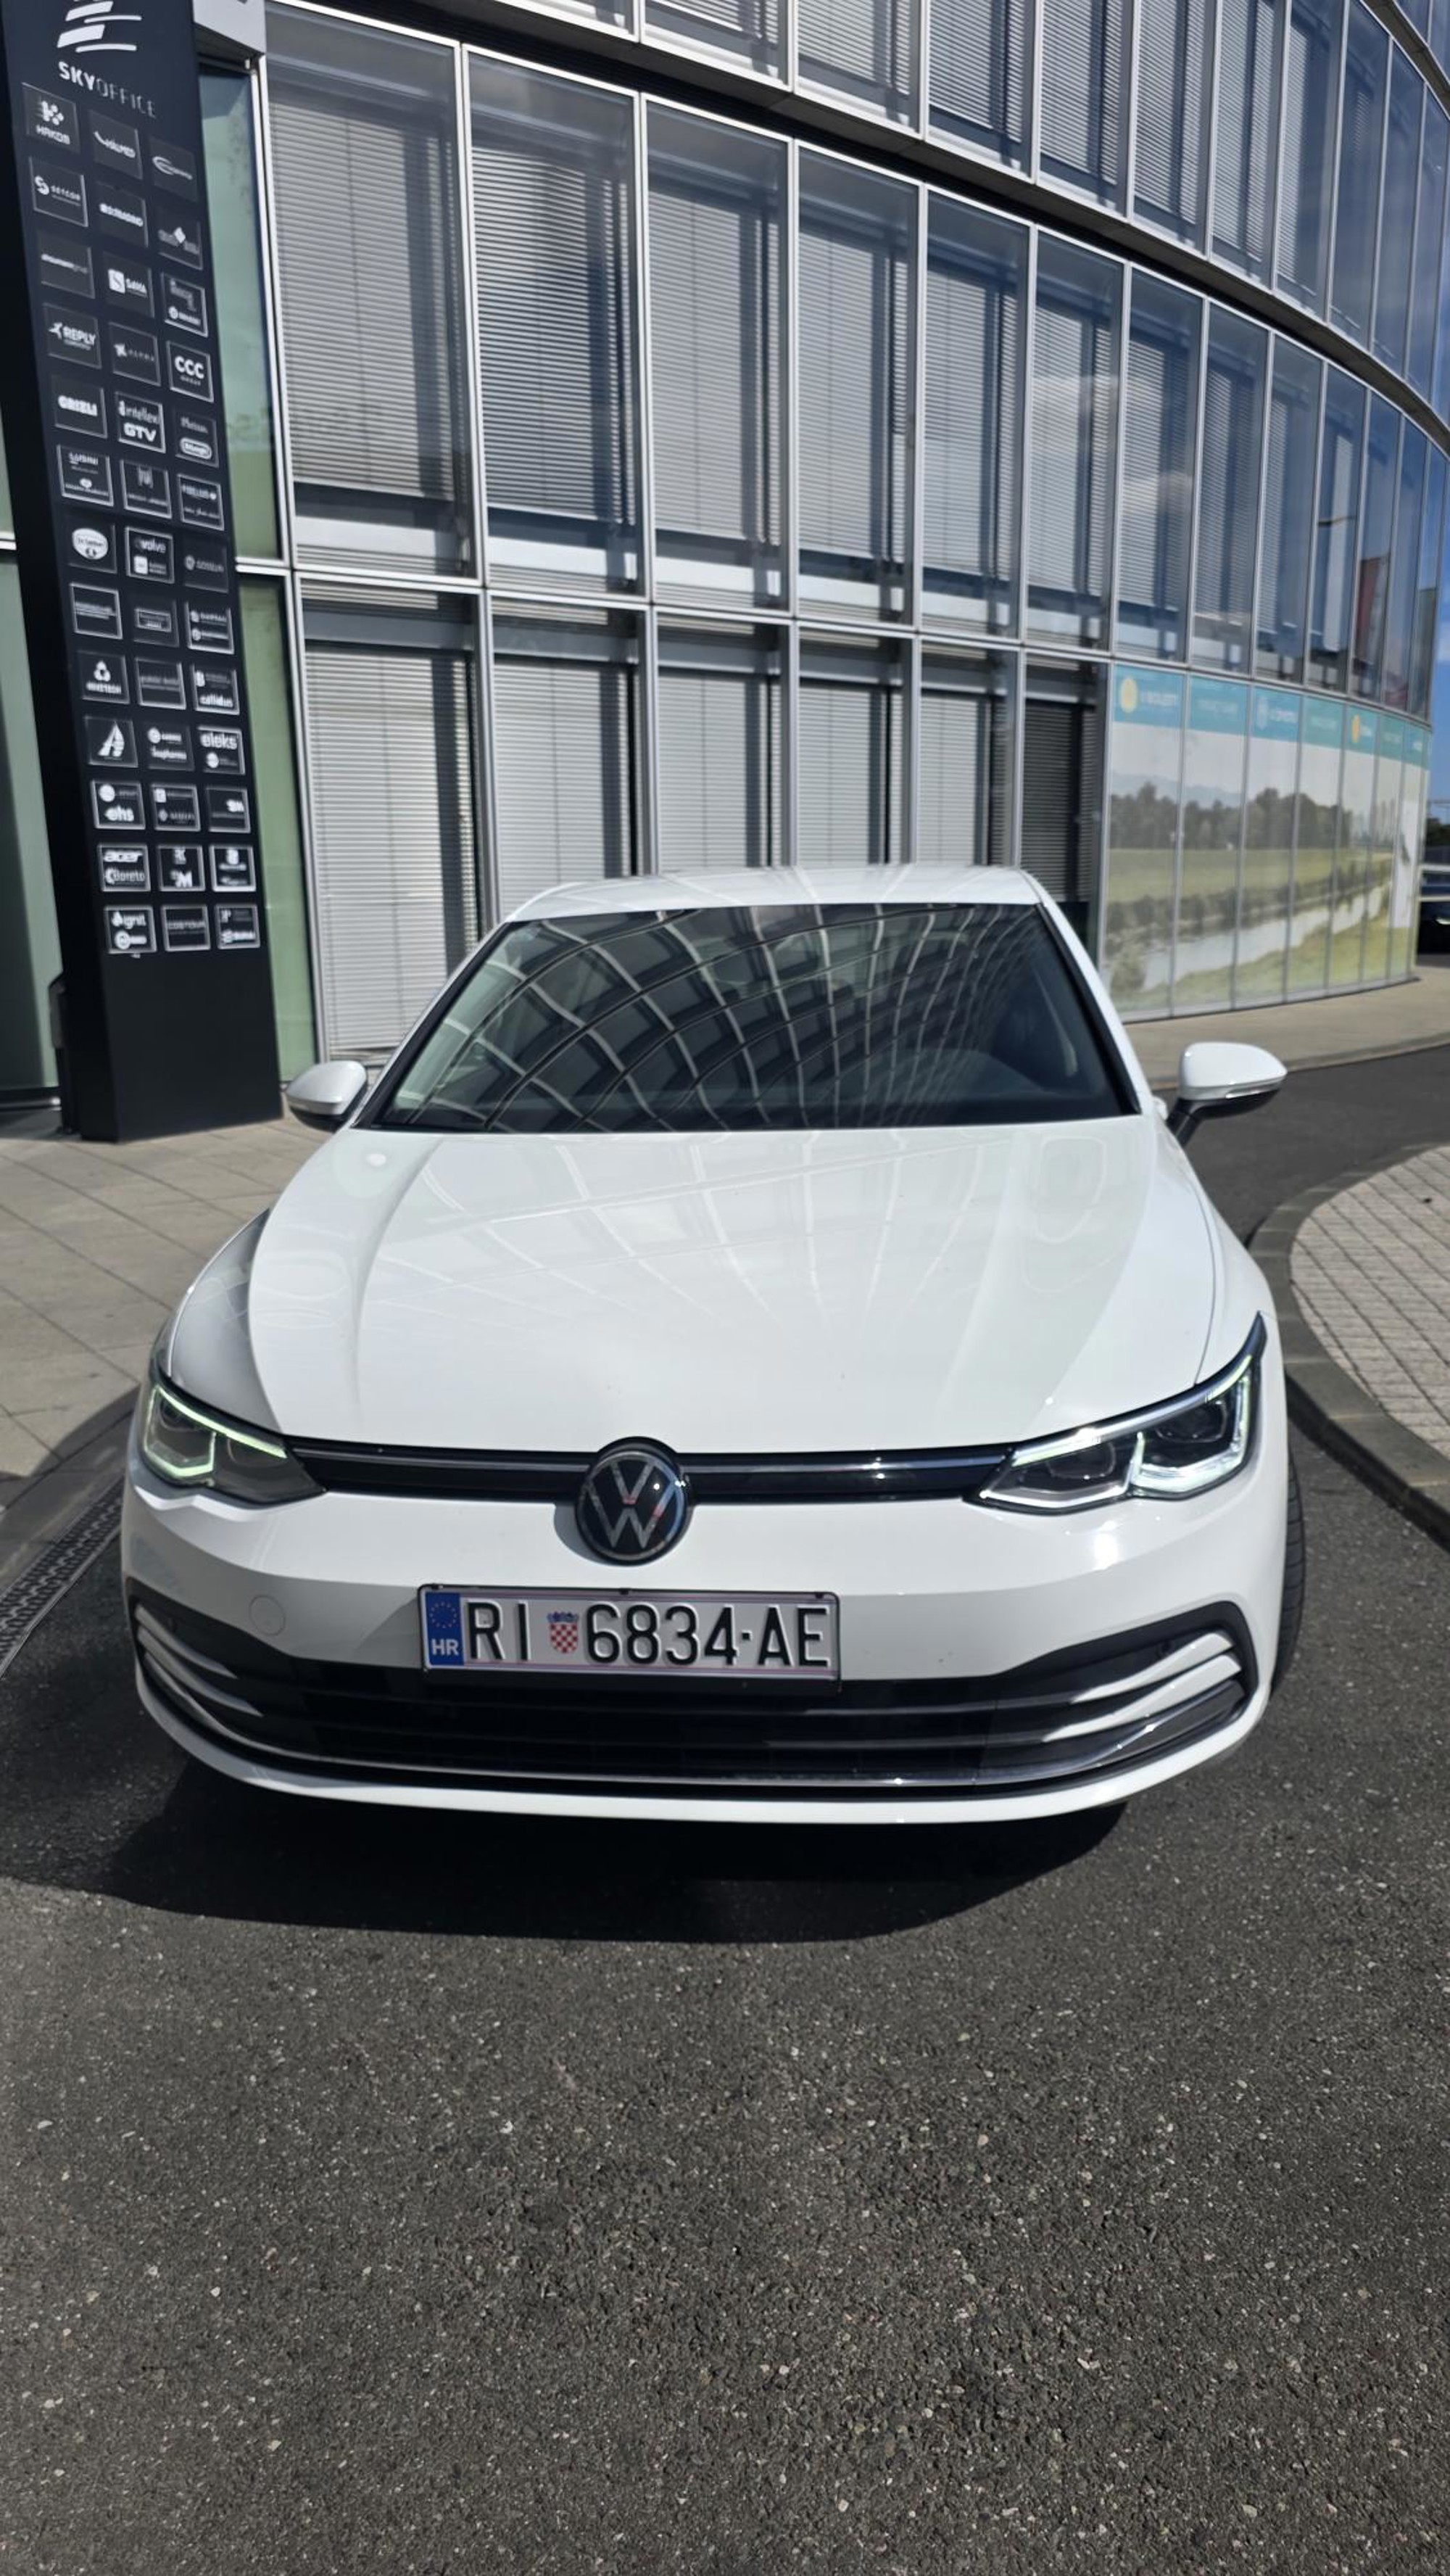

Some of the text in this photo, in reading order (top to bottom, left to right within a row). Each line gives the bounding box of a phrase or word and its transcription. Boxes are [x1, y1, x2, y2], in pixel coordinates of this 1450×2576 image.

[58, 61, 156, 119] SKYOFFICE
[62, 326, 96, 346] REPLY
[175, 355, 204, 379] CCC
[124, 423, 157, 442] GTV
[200, 732, 237, 750] eleks
[104, 850, 143, 862] acer
[468, 1601, 529, 1661] RI
[431, 1639, 460, 1658] HR
